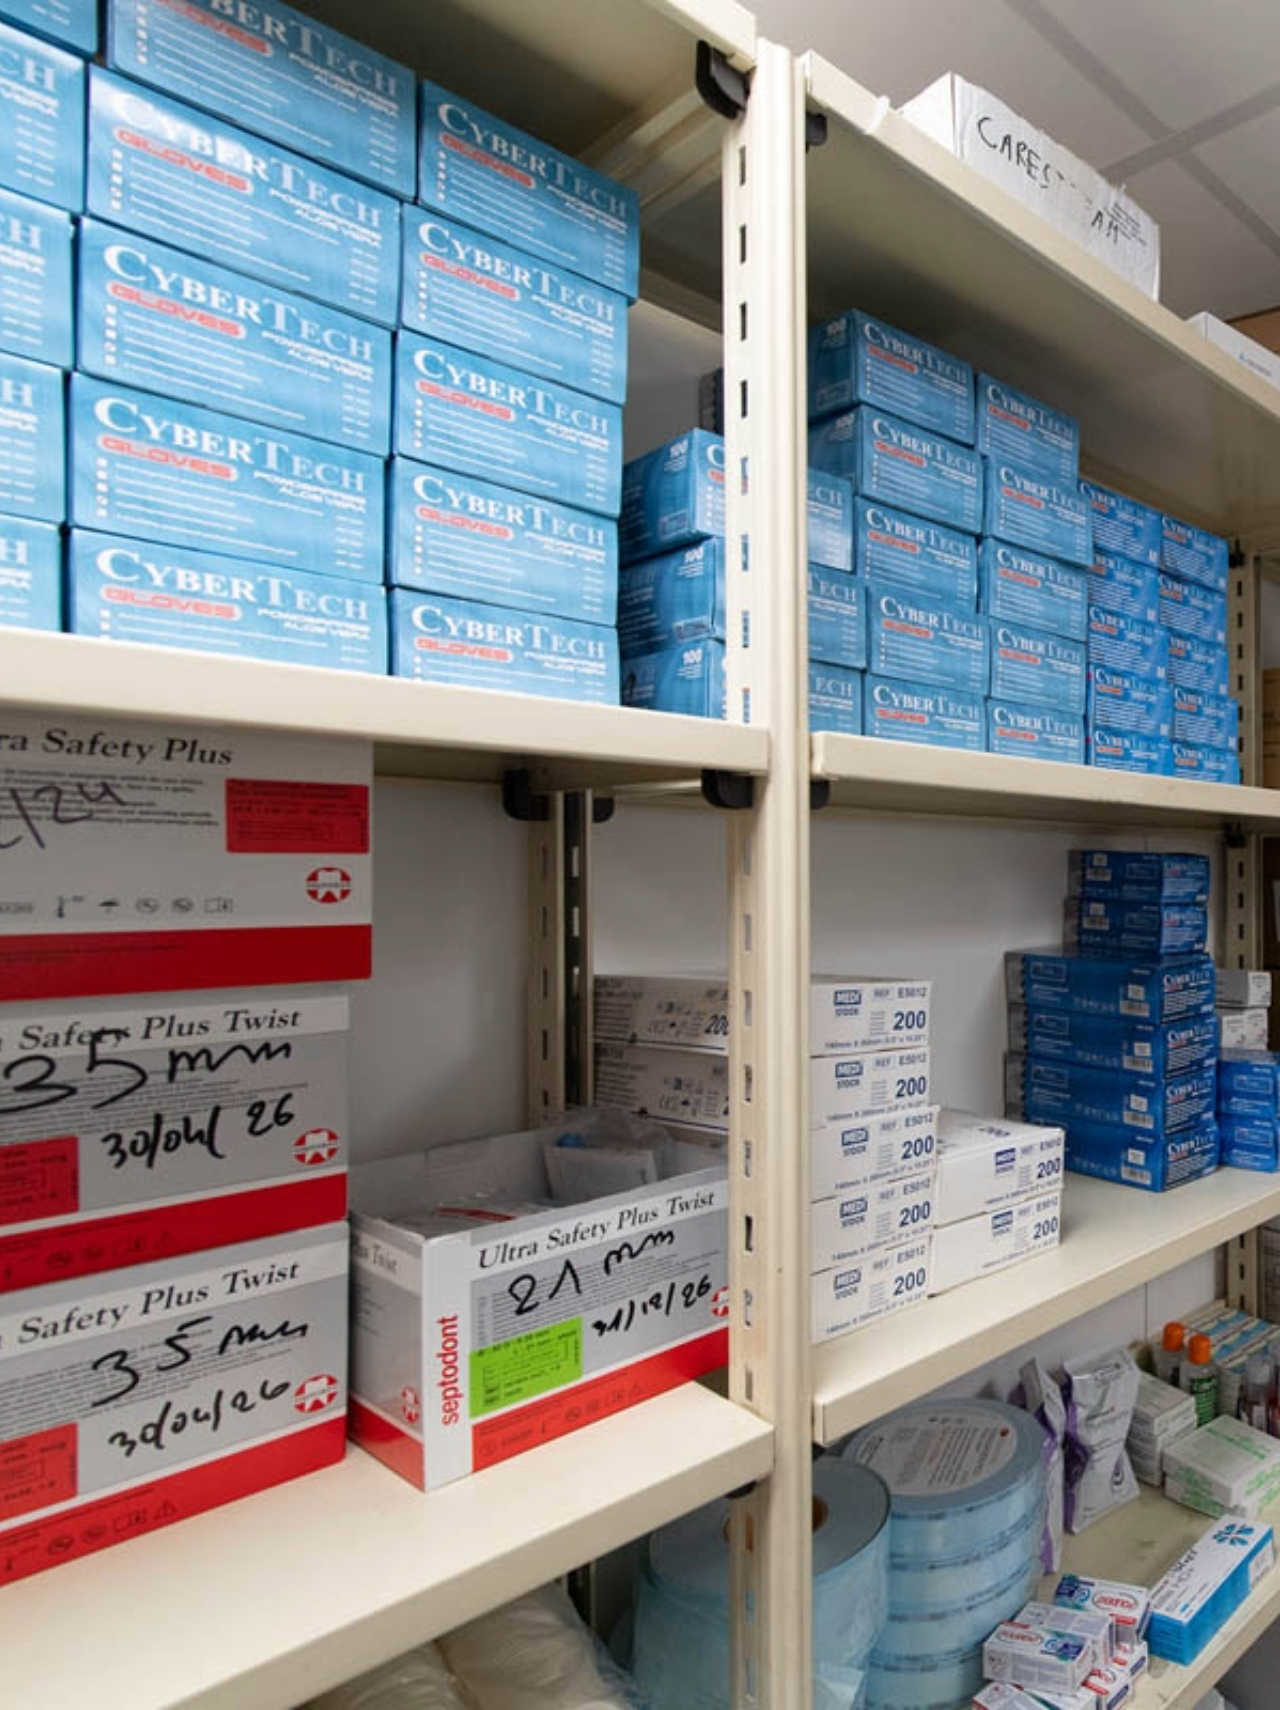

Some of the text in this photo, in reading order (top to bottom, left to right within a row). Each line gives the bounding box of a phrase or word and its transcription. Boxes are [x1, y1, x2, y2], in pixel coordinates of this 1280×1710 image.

[42, 728, 156, 765] Safety
[162, 736, 233, 766] Plus
[141, 1014, 211, 1041] Plus
[224, 1008, 302, 1034] Twist
[892, 1010, 927, 1031] 200
[895, 1076, 927, 1098] 200
[901, 1135, 935, 1160] 200
[1036, 1157, 1061, 1179] 200
[899, 1200, 931, 1227] 200
[477, 1190, 716, 1271] Ultra Safety Plus Twist
[1033, 1216, 1058, 1240] 200
[893, 1267, 926, 1296] 200
[17, 1261, 301, 1346] Safety Plus Twist
[442, 1314, 462, 1426] septodont
